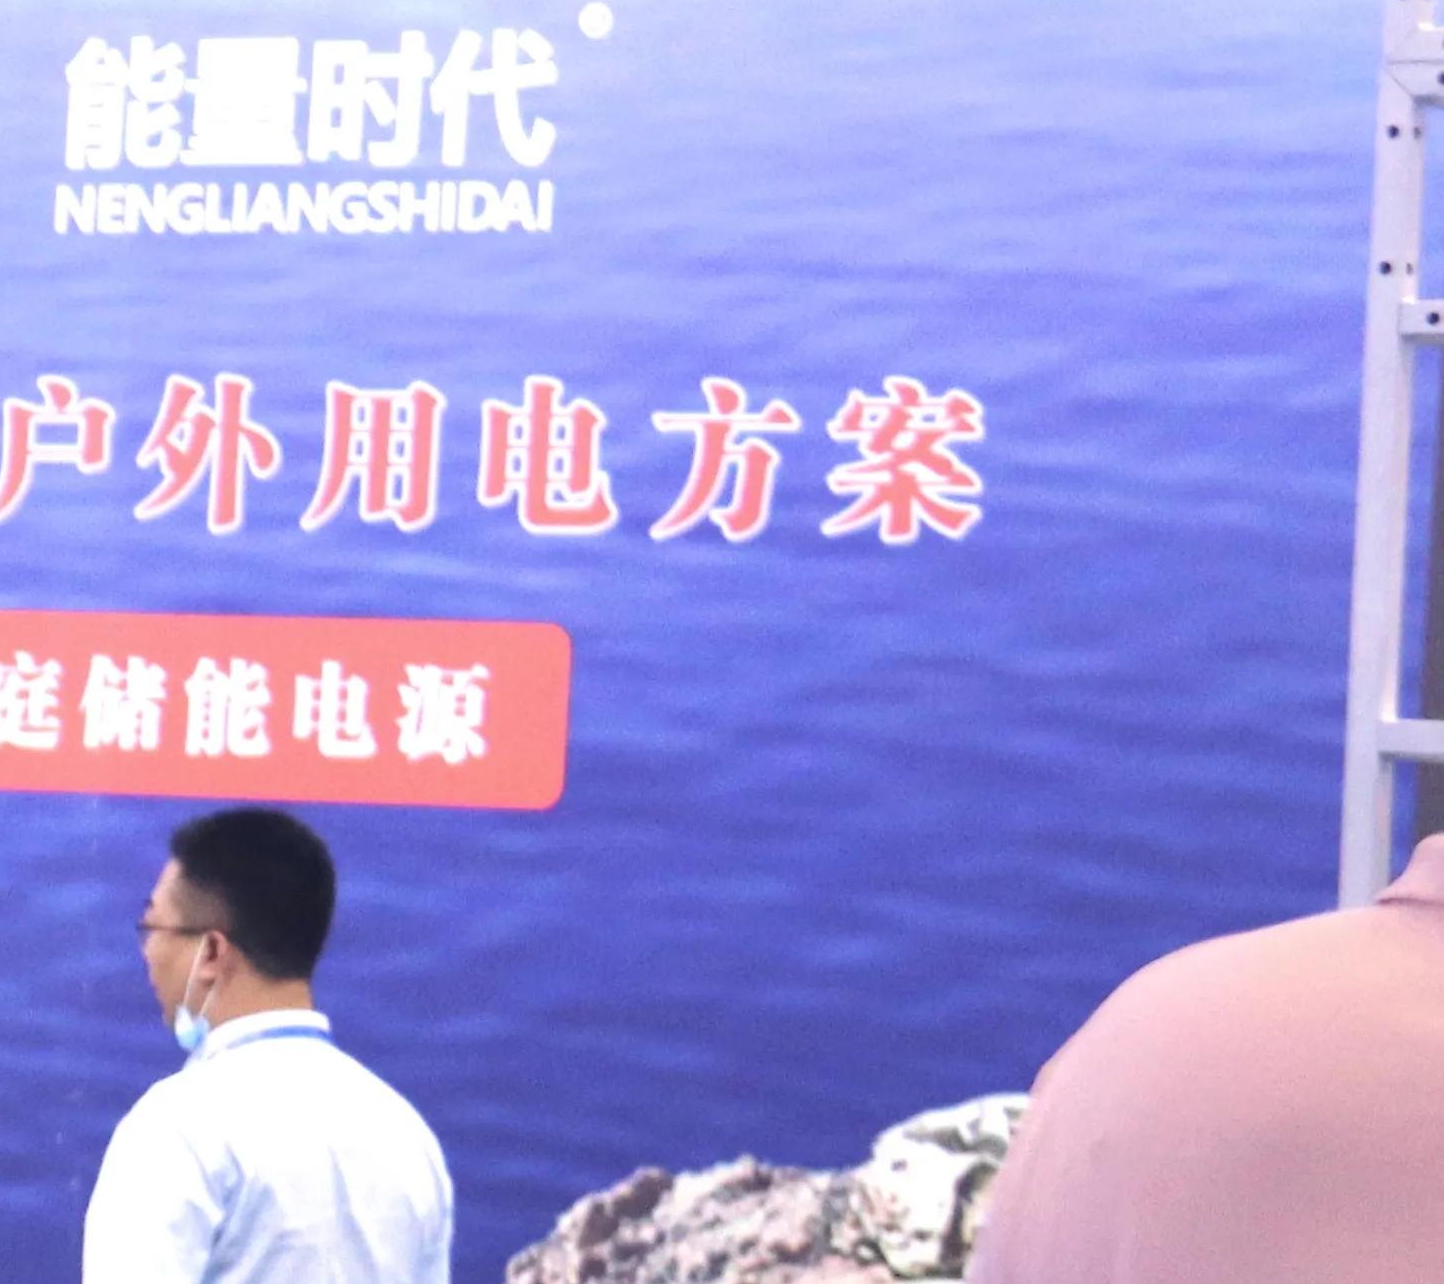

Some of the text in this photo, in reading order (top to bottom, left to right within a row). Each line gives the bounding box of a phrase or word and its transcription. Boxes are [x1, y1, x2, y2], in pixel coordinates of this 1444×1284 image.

[63, 26, 559, 170] 能量时代
[53, 179, 555, 234] NENGLIANGSHIDAI
